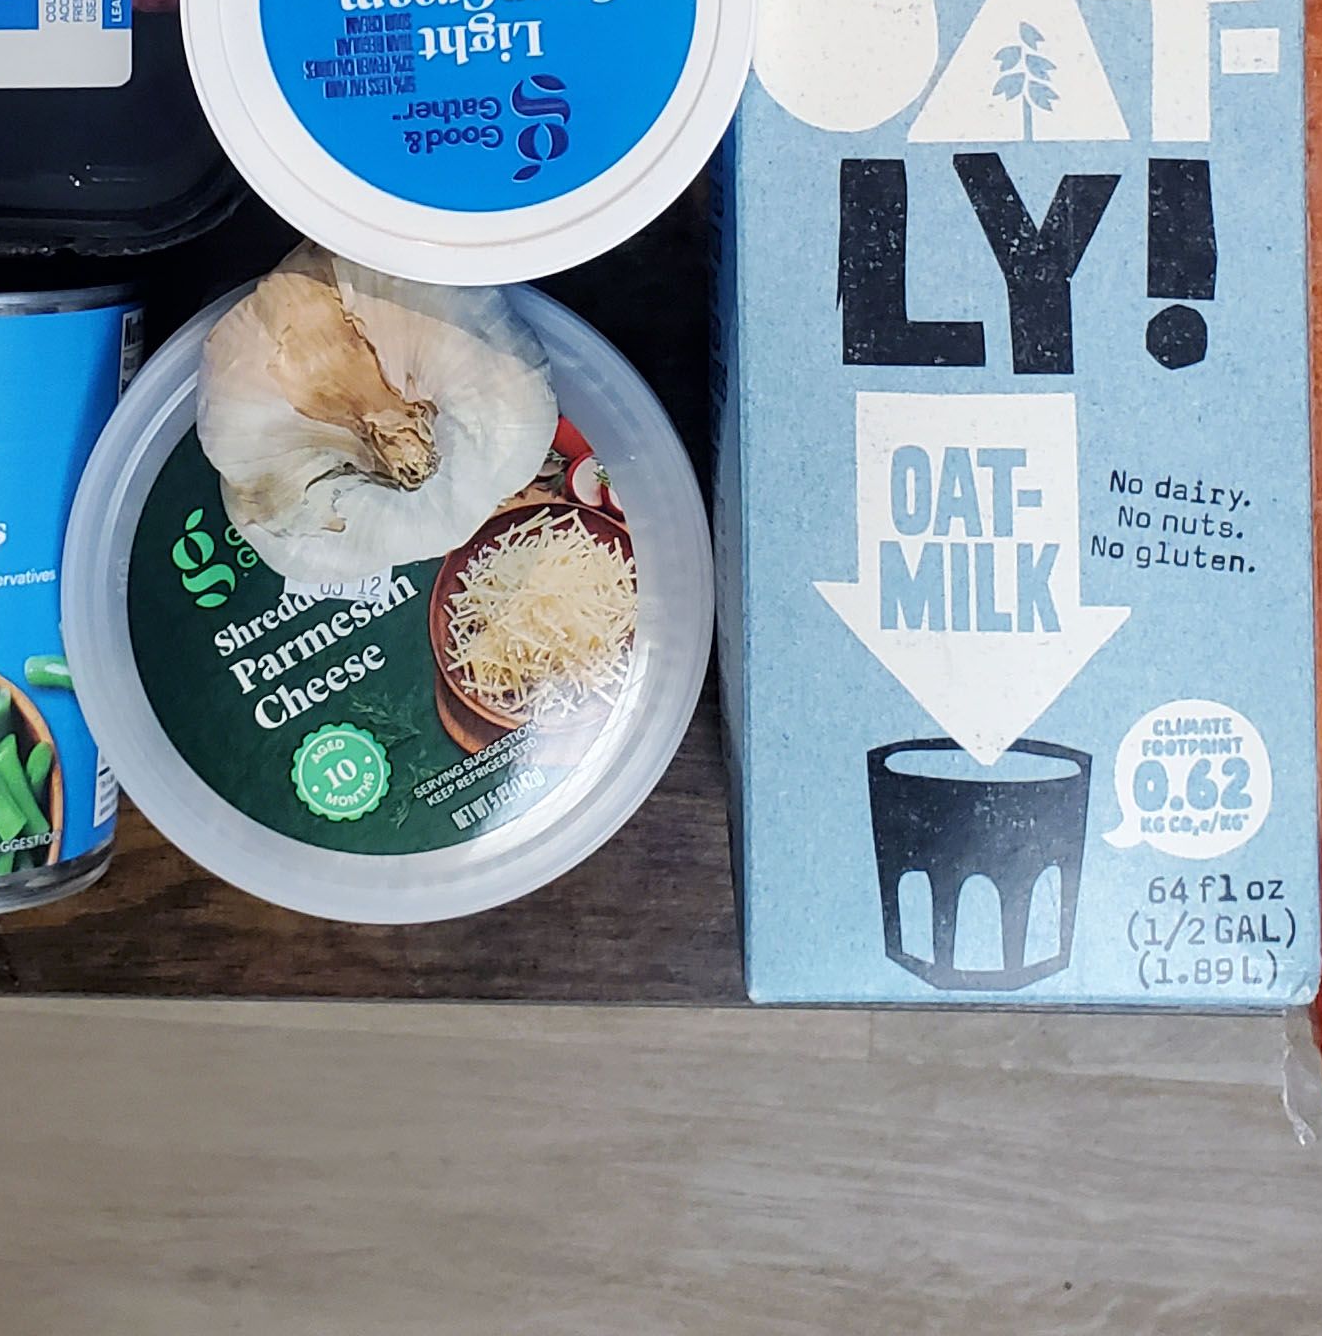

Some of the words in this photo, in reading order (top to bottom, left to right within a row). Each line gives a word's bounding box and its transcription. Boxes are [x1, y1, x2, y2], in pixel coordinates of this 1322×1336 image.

[418, 12, 544, 65] Light
[836, 151, 1218, 375] LY!
[886, 444, 1044, 538] OAT-
[1109, 470, 1146, 496] No
[1154, 475, 1253, 510] dairy.
[1116, 506, 1155, 530] No
[1161, 513, 1246, 539] nuts.
[1089, 535, 1127, 562] No
[1133, 540, 1258, 576] gluten.
[358, 575, 381, 597] 12
[879, 540, 1062, 635] MILK
[253, 641, 388, 732] Cheese
[1150, 716, 1234, 738] CLIMATE
[309, 737, 346, 766] AGED
[321, 757, 358, 791] 10
[324, 770, 377, 809] MONTHS
[1132, 755, 1254, 814] 0.62
[1147, 878, 1190, 903] 64
[1245, 877, 1286, 901] oz
